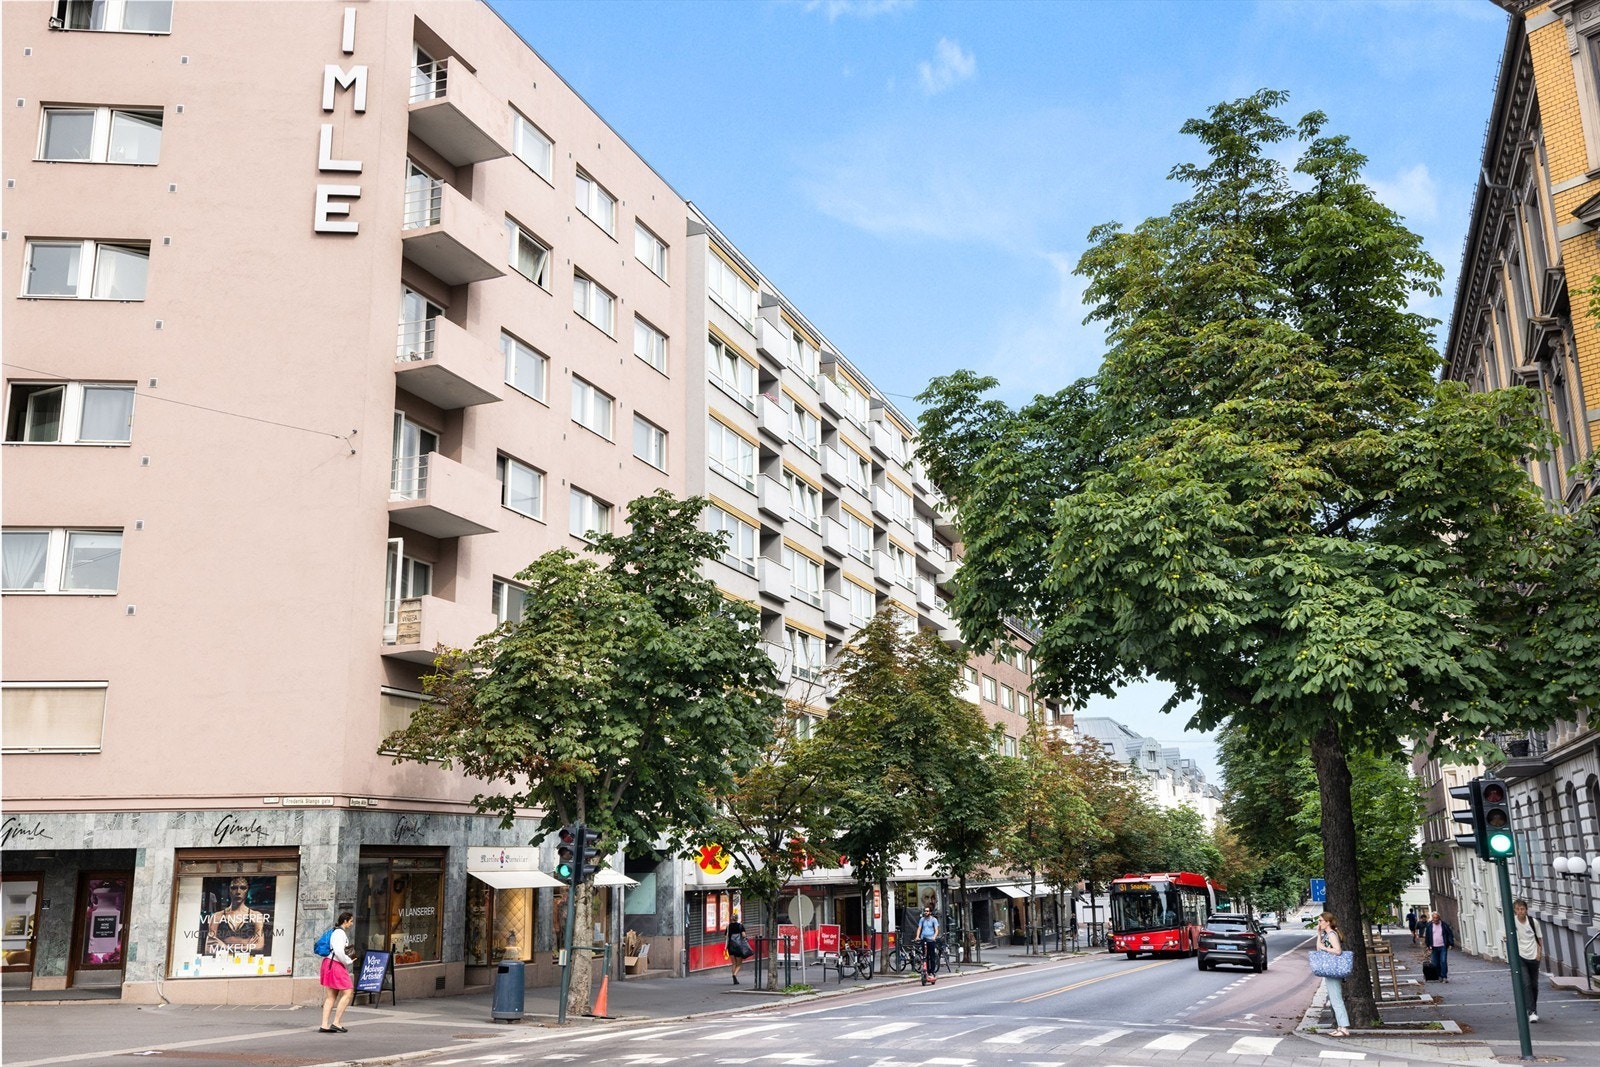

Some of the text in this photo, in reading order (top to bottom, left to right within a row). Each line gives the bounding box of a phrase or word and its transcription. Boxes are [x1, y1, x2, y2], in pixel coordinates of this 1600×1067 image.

[314, 0, 370, 234] IMLE
[1119, 883, 1127, 891] 31
[398, 906, 435, 917] VI LANSERER
[199, 912, 271, 924] VI LANSERER
[403, 934, 428, 944] MAKEUP
[209, 943, 257, 954] MAKEUP
